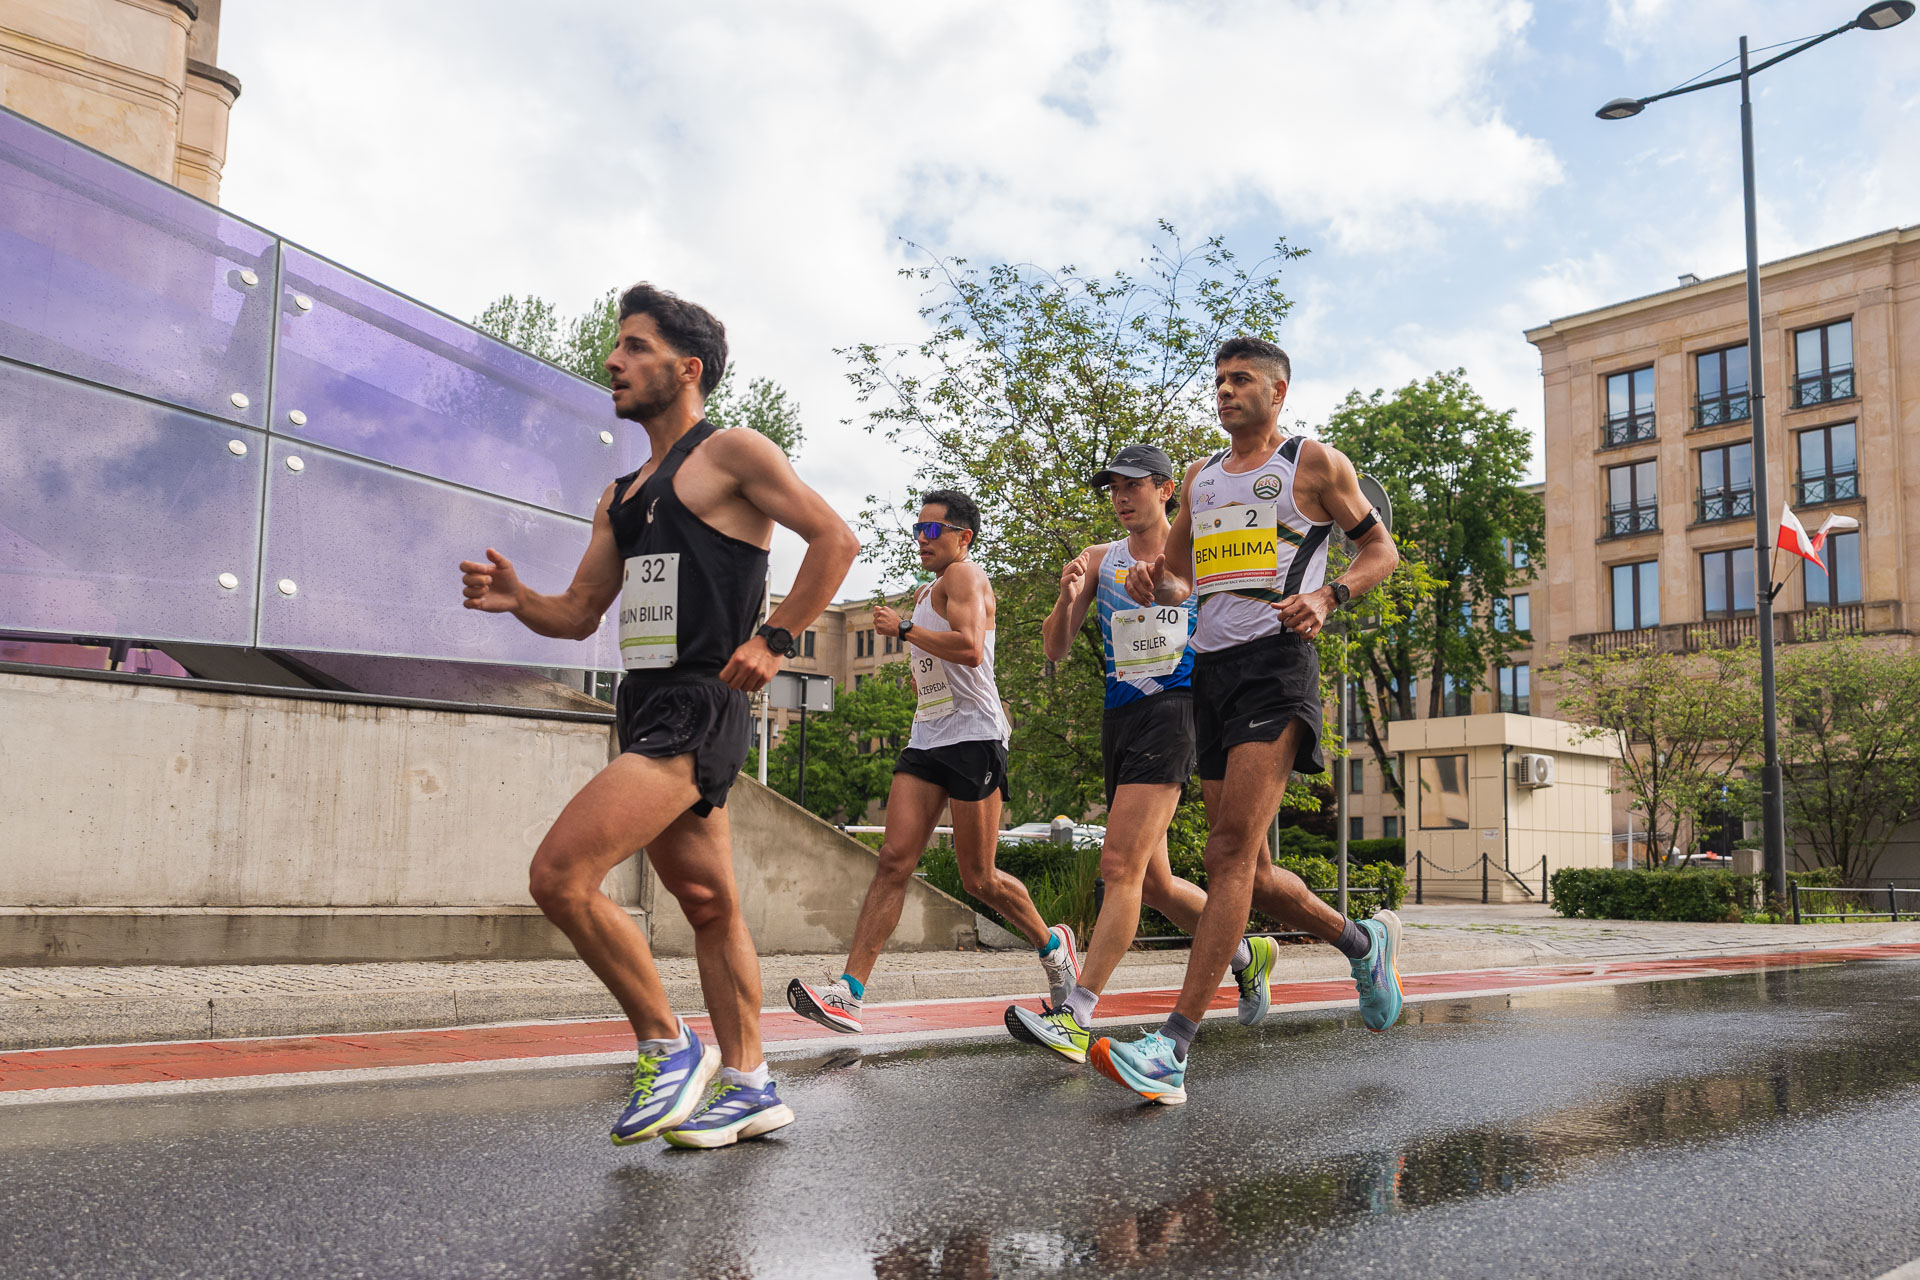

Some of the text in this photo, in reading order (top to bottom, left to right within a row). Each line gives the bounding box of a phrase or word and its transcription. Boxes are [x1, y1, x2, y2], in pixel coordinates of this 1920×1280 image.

[1245, 509, 1258, 528] 2
[1196, 541, 1275, 564] BEN HLIMA
[641, 558, 666, 583] 32
[640, 605, 673, 622] BILIR
[1156, 608, 1179, 625] 40
[1133, 636, 1167, 651] SEILER
[919, 658, 933, 673] 39
[922, 682, 946, 695] ZEPEDA
